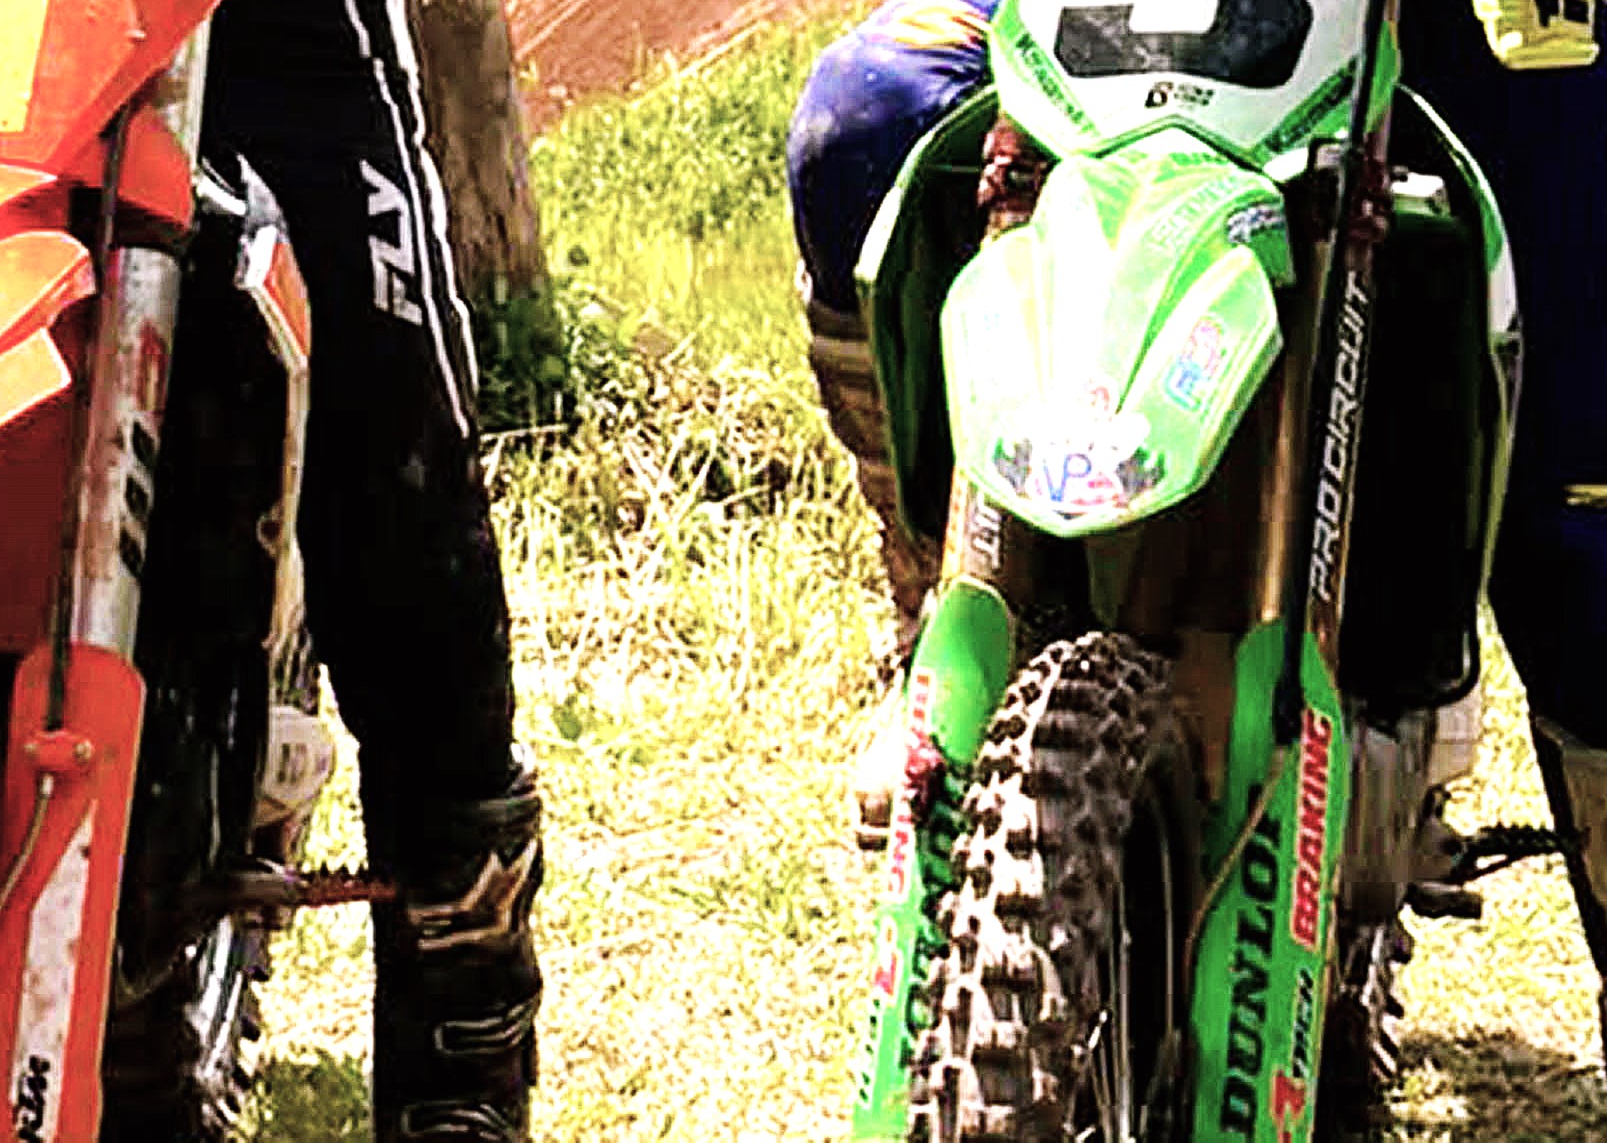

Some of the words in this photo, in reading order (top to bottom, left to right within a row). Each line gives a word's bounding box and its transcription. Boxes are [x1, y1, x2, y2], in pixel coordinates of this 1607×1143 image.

[358, 158, 423, 326] FLY
[1321, 270, 1371, 480] CIRCUIT
[1307, 480, 1343, 604] PRO
[1291, 708, 1334, 949] BRAKING
